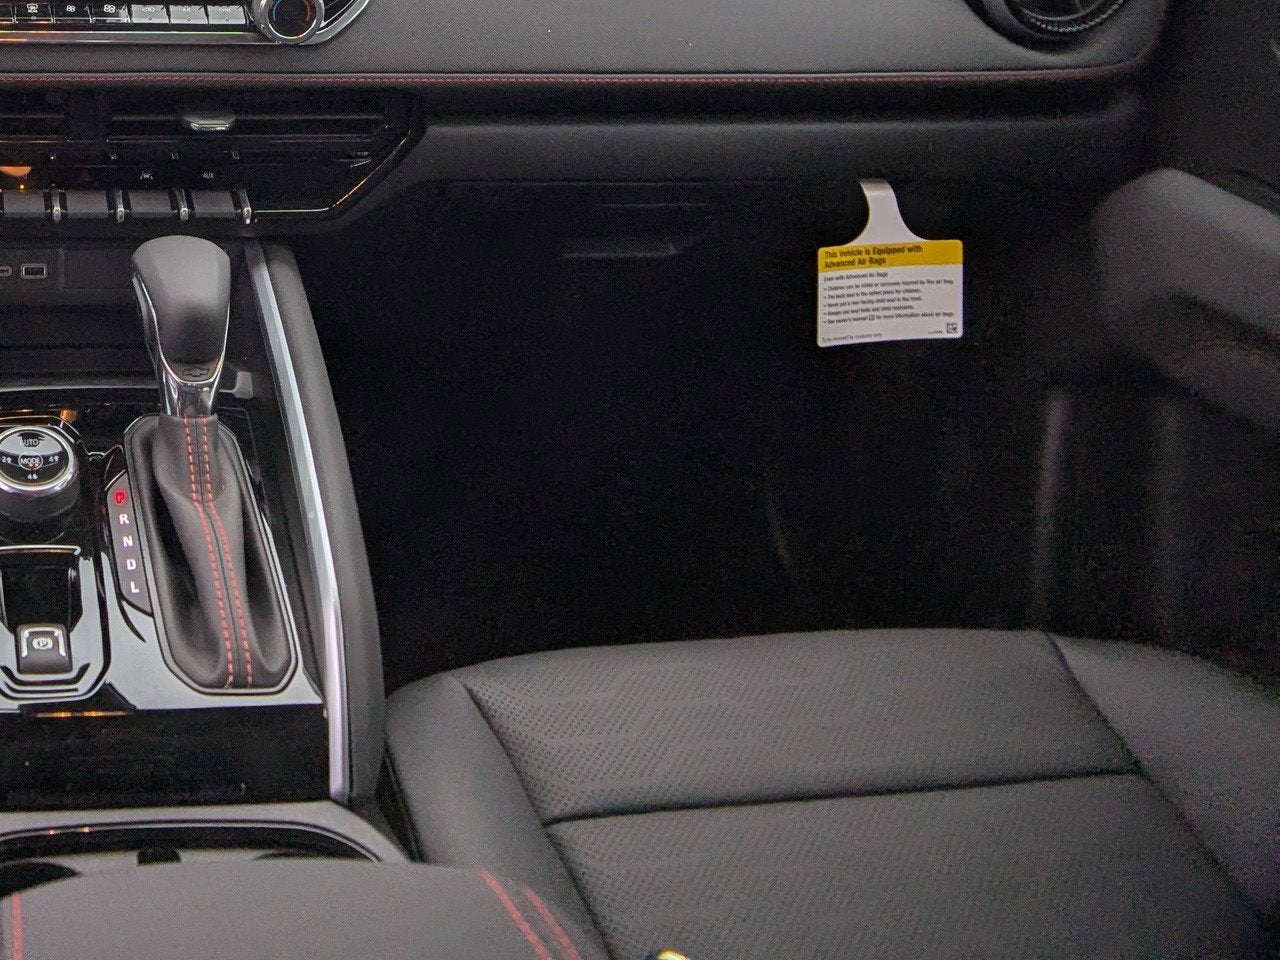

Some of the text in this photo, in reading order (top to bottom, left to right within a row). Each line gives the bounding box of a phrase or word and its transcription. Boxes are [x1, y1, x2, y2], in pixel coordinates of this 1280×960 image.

[824, 250, 838, 258] This
[872, 246, 906, 255] Equipped
[907, 245, 923, 253] with
[825, 259, 856, 268] Advanced
[114, 491, 125, 504] P
[119, 513, 130, 525] R
[123, 535, 133, 548] N
[126, 559, 137, 571] D
[130, 581, 140, 594] L
